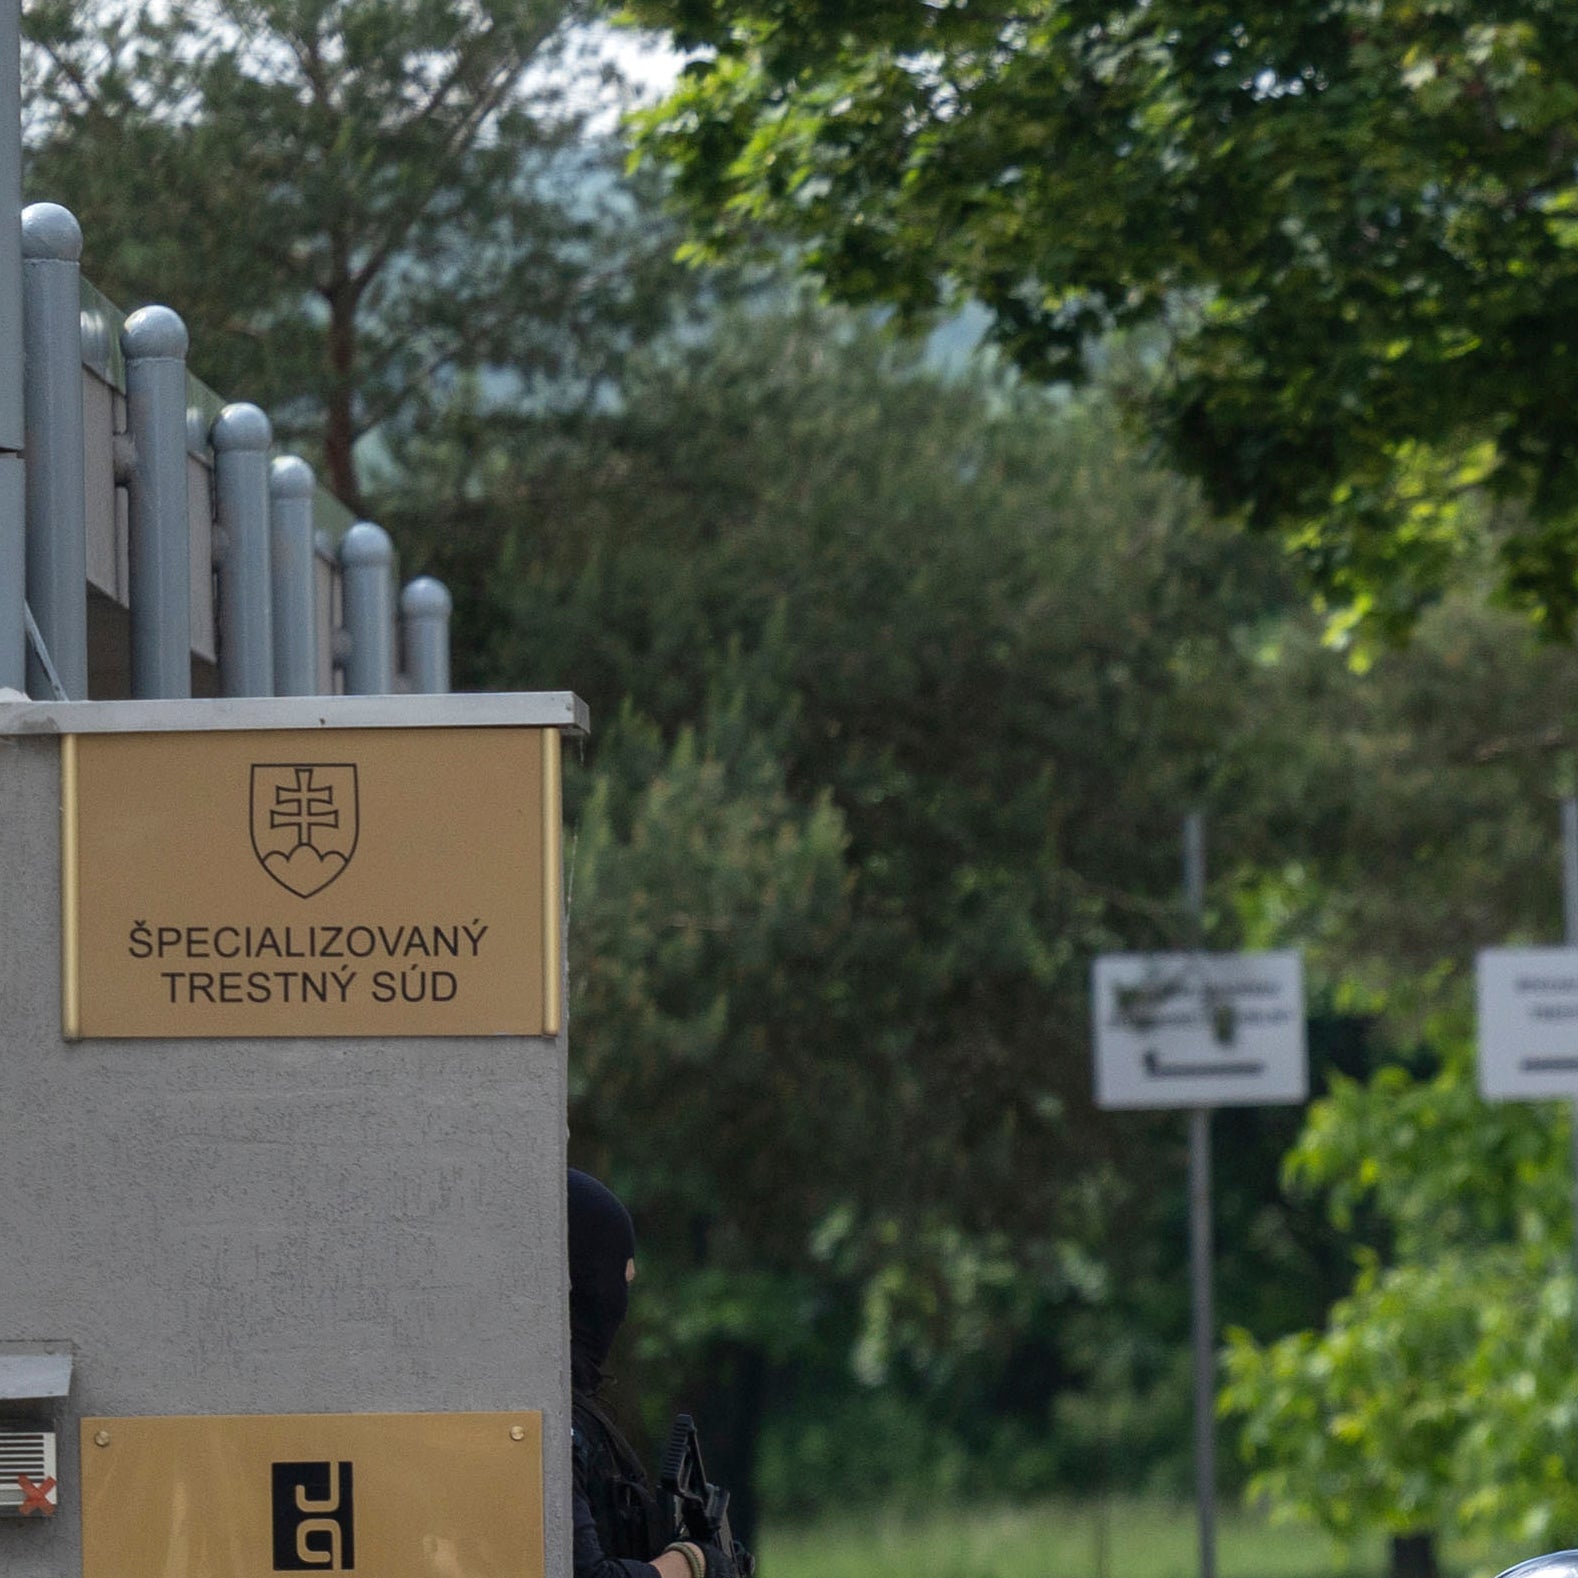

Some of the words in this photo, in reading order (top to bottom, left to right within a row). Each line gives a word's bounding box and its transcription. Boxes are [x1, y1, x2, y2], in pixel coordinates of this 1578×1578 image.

[128, 918, 489, 959] ŠPECIALIZOVANÝ
[161, 964, 357, 1003] TRESTNÝ
[371, 963, 458, 1003] SÚD
